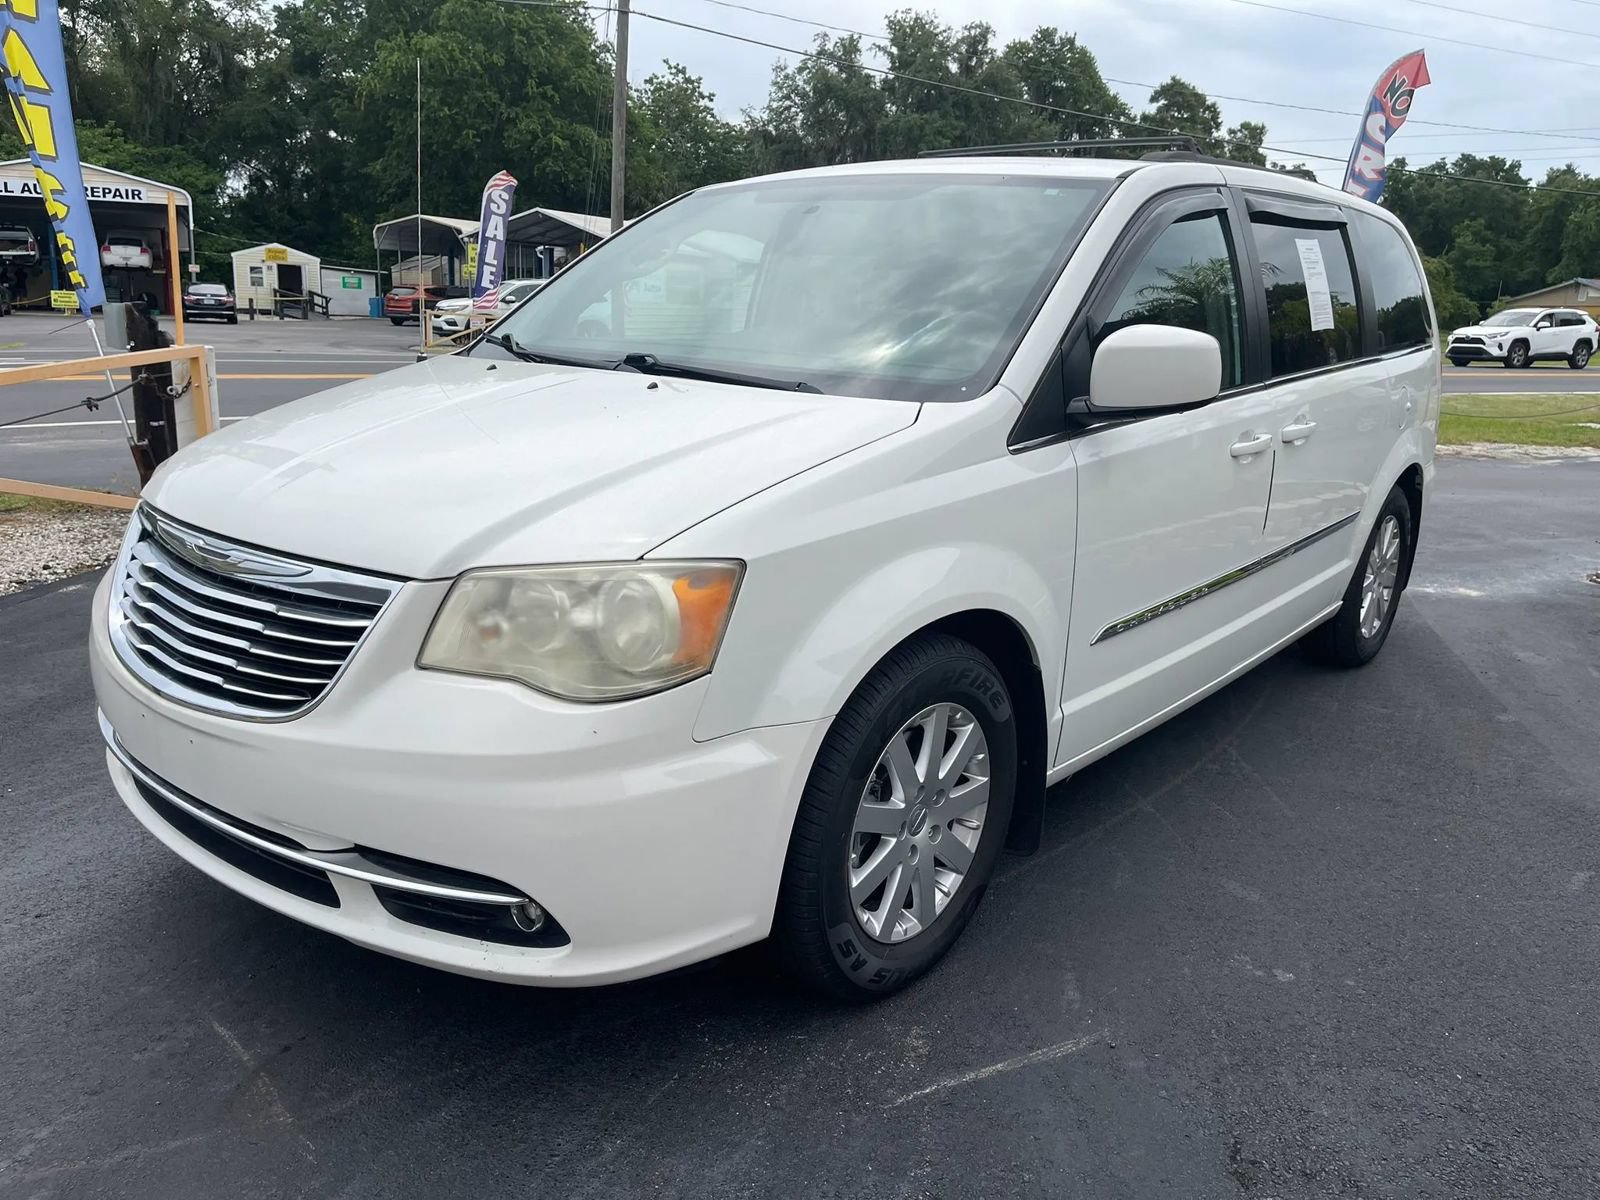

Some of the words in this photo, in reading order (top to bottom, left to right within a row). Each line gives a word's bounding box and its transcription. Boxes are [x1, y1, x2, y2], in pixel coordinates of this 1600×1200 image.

[1383, 71, 1415, 118] NO
[20, 182, 42, 195] AU
[84, 186, 143, 200] REPAIR
[481, 189, 509, 289] SALE
